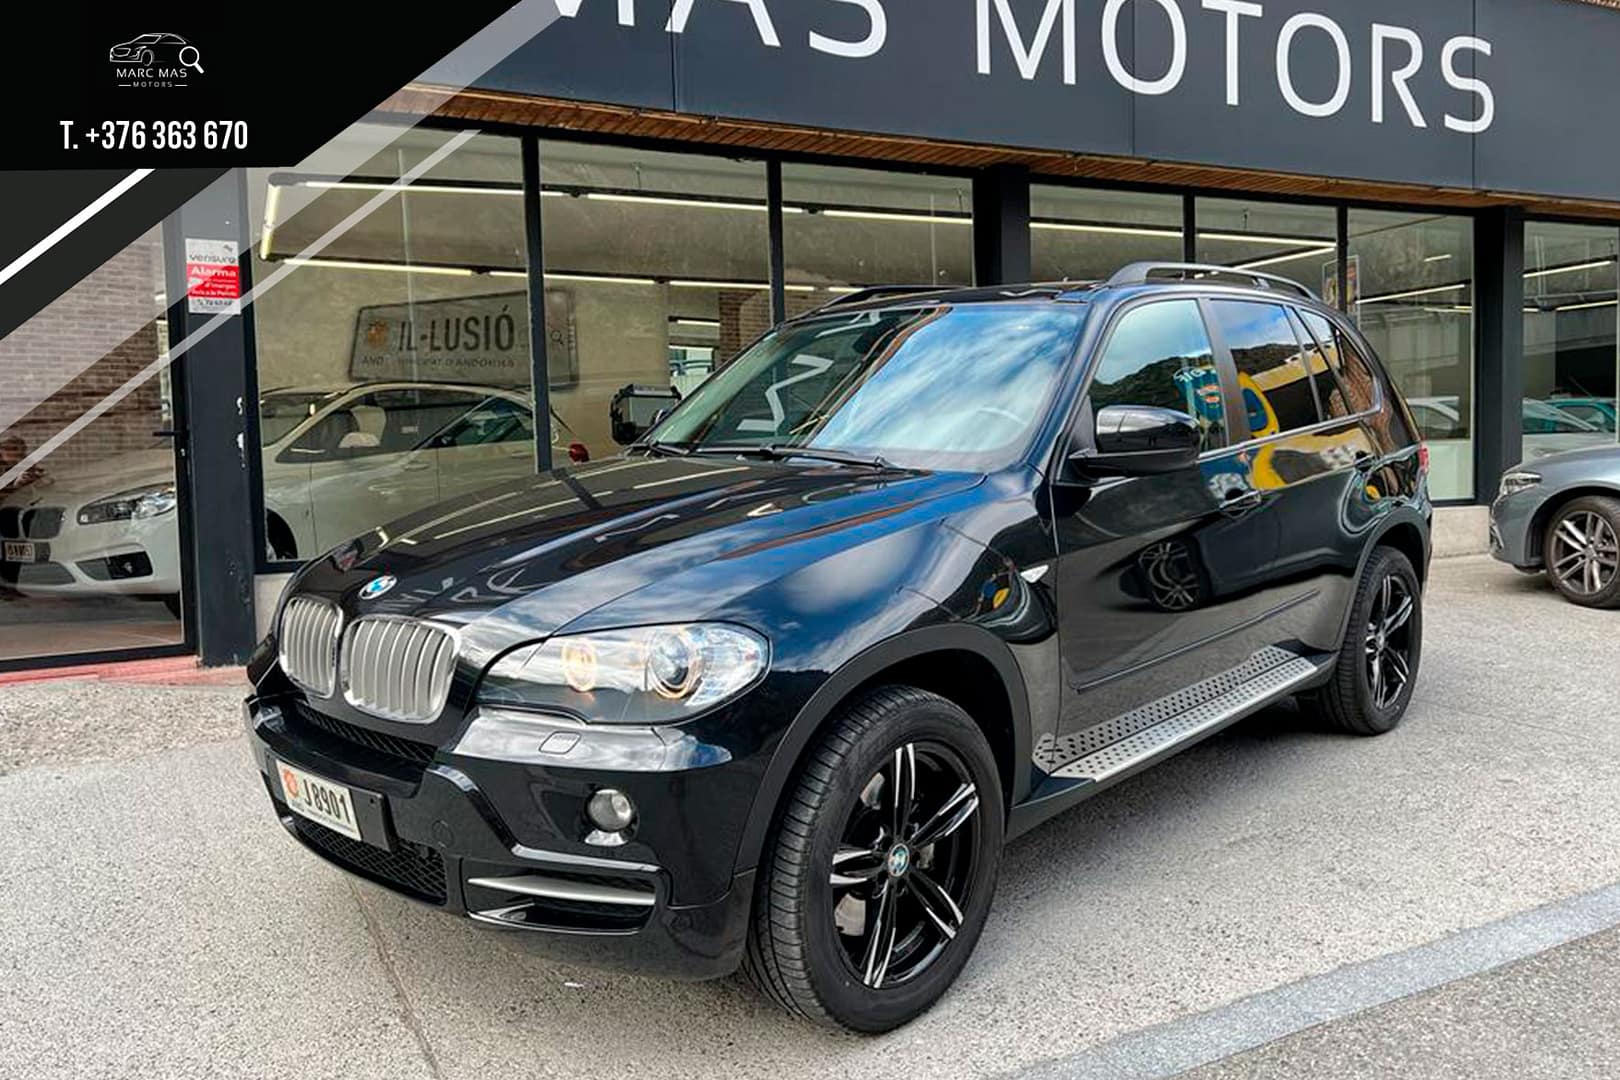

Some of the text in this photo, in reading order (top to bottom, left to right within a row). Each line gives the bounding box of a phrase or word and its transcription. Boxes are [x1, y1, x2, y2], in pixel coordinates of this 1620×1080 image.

[975, 0, 1495, 133] MOTORS
[191, 265, 237, 278] Alarma
[303, 779, 350, 824] J8901
